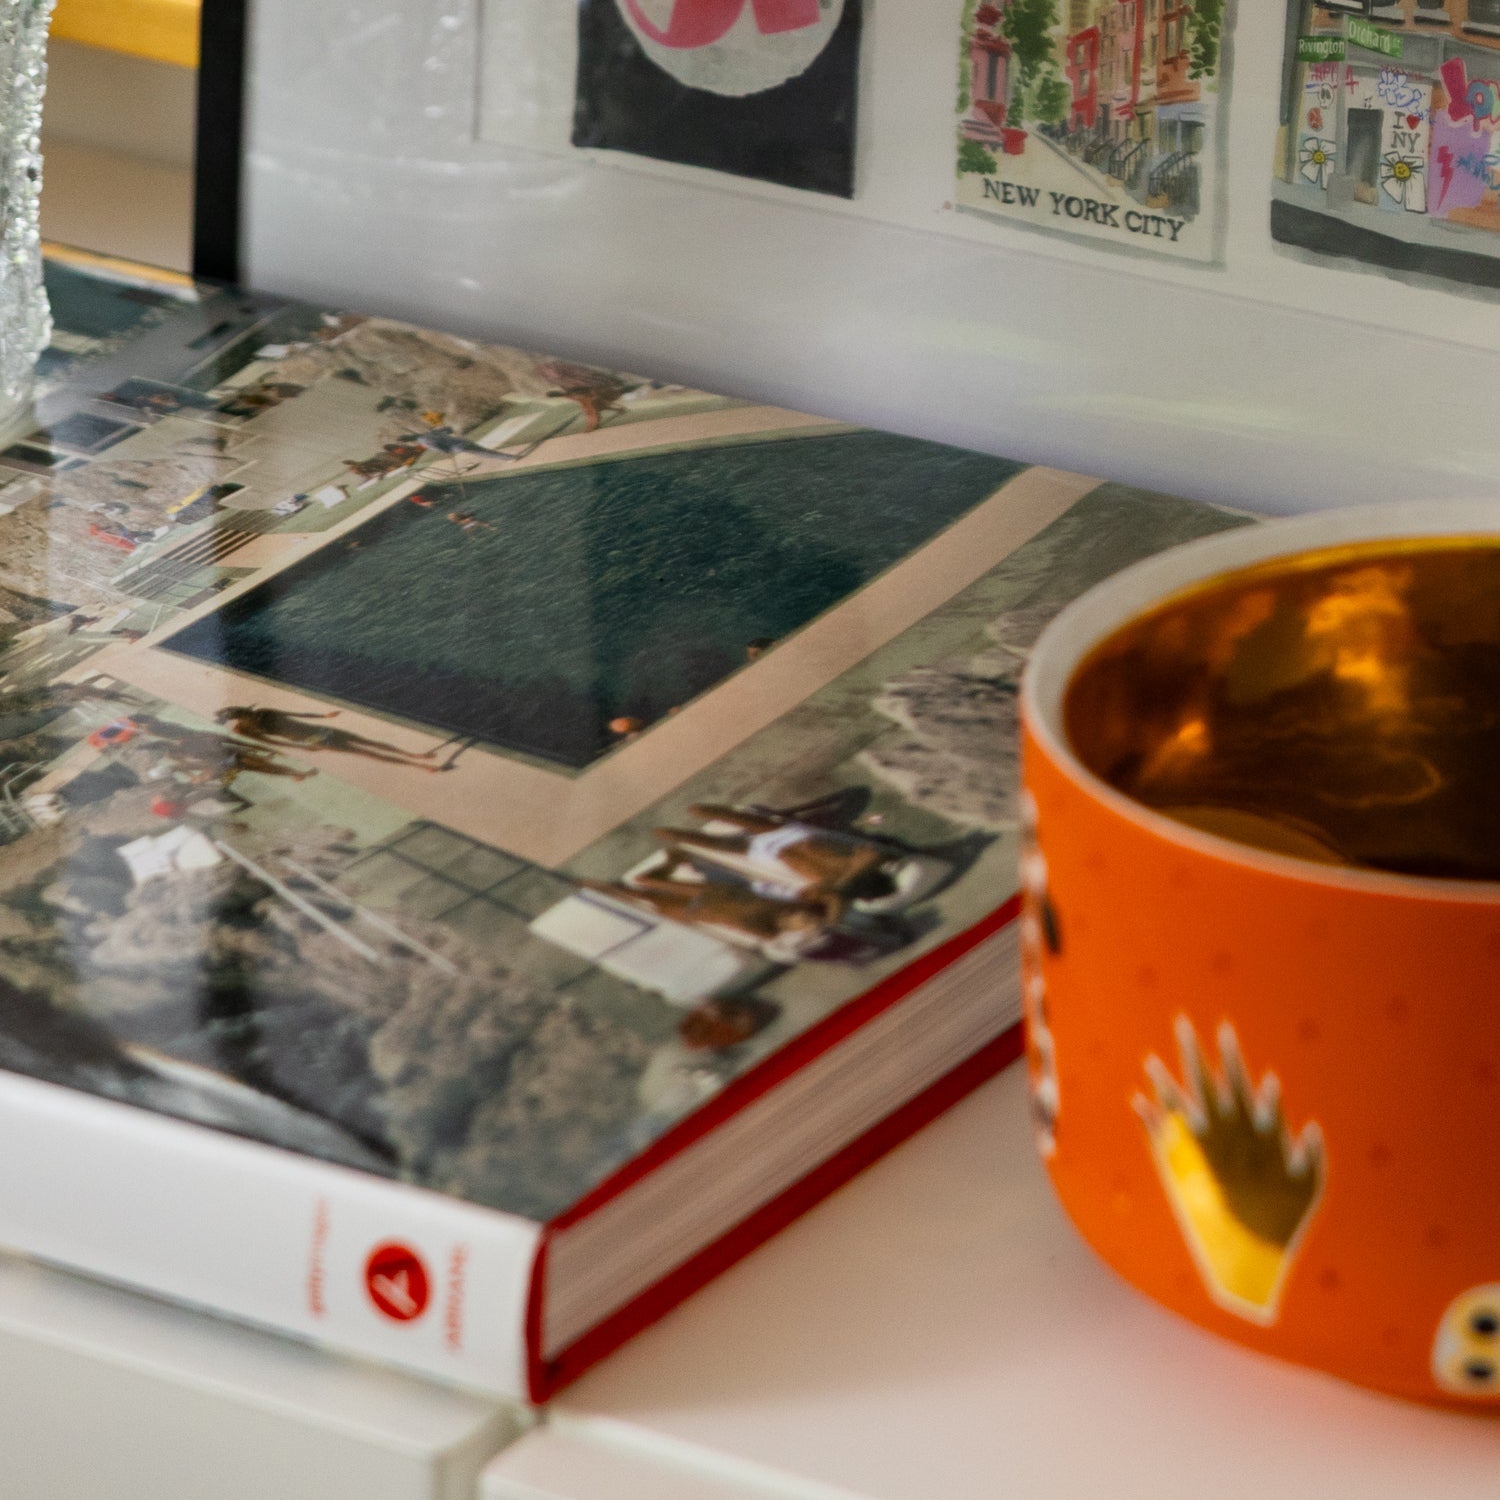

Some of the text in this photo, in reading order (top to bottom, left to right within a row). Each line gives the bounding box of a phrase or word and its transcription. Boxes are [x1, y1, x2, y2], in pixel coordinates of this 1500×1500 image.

[1299, 38, 1345, 60] Rivington
[1349, 20, 1391, 53] Orchard
[982, 176, 1186, 244] NEW YORK CITY
